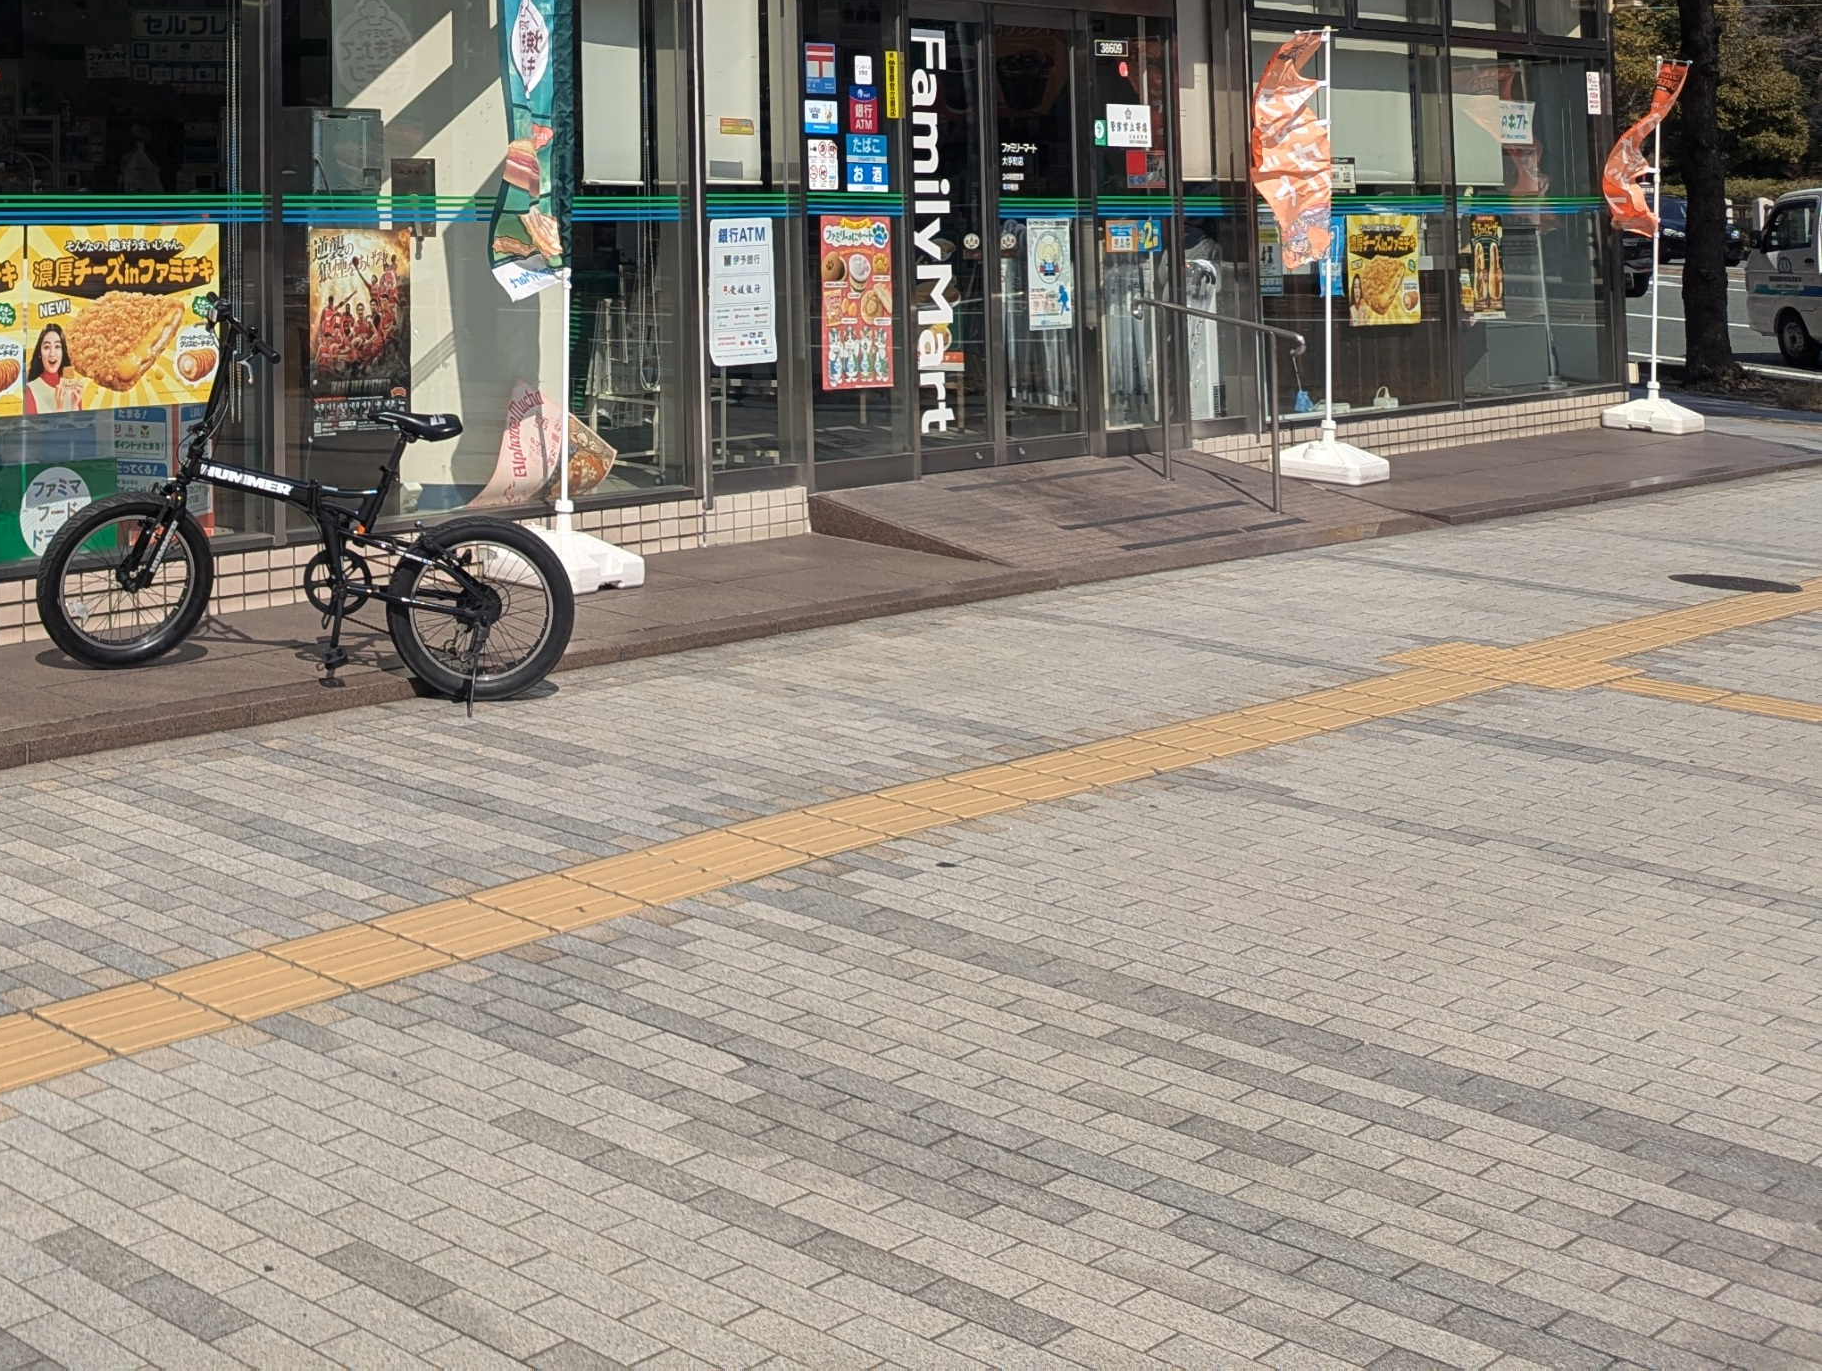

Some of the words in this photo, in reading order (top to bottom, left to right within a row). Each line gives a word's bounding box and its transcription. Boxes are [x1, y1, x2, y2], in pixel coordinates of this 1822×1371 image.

[855, 104, 872, 118] 銀行
[855, 120, 872, 130] ATM
[853, 138, 881, 153] たばこ
[1001, 143, 1038, 154] ファミリーマート
[718, 226, 766, 243] 銀行ATM
[910, 28, 955, 435] FamilyMart
[64, 239, 184, 251] そんなの、絶対うまいじゃん。
[314, 234, 354, 261] 逆襲の
[733, 254, 760, 265] 伊予銀行
[33, 254, 215, 287] 濃厚チーズinファミチキ
[38, 299, 70, 318] NEW!
[32, 478, 82, 499] ファミマ
